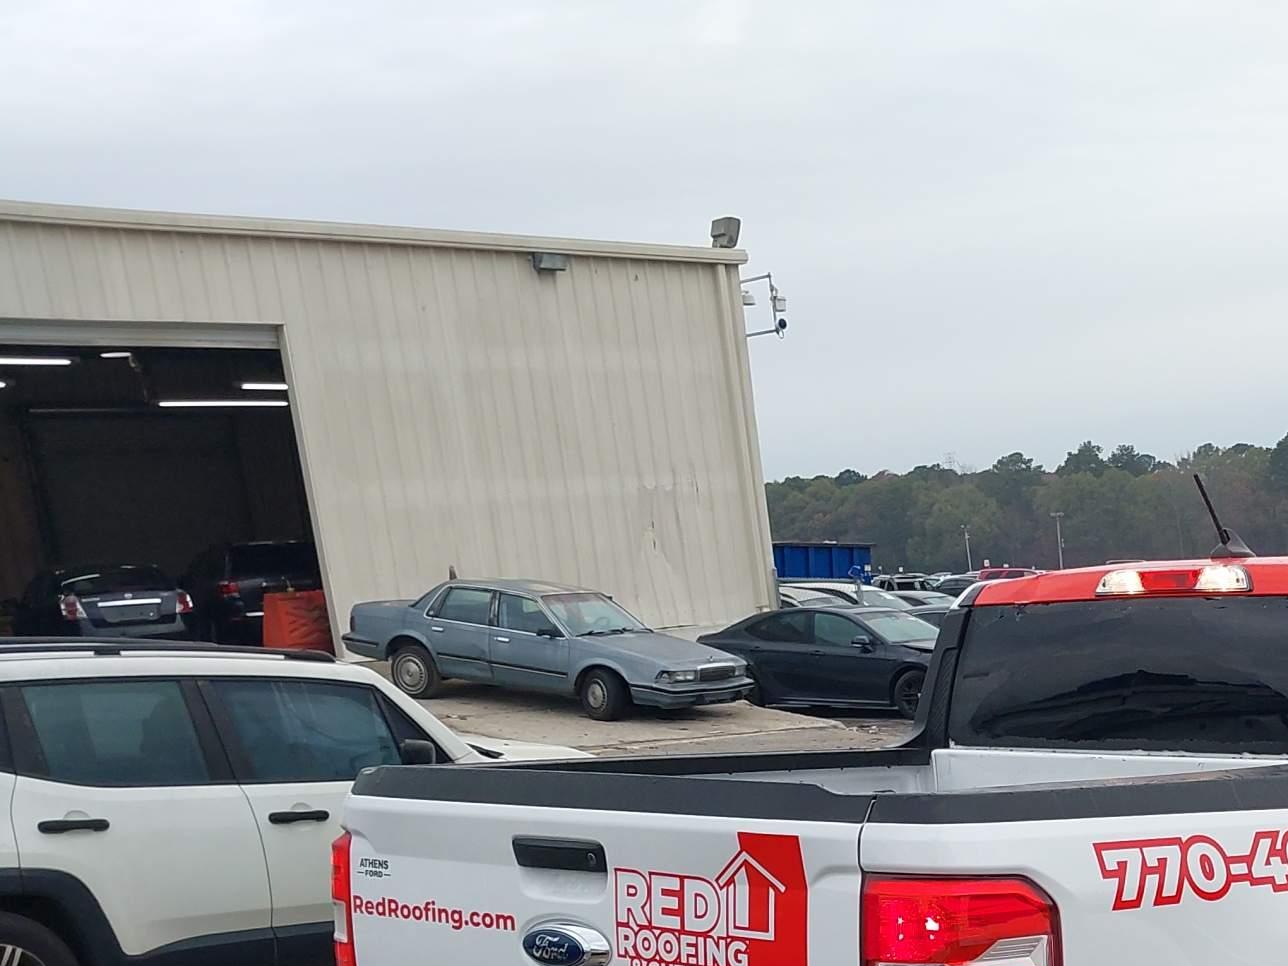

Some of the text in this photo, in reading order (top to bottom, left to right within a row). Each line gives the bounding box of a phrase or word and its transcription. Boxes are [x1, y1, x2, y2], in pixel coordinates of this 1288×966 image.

[359, 858, 389, 870] ATHENS
[365, 869, 383, 878] FORD
[352, 895, 516, 932] RedRoofing.com
[614, 867, 721, 935] RED
[532, 934, 570, 961] Ford
